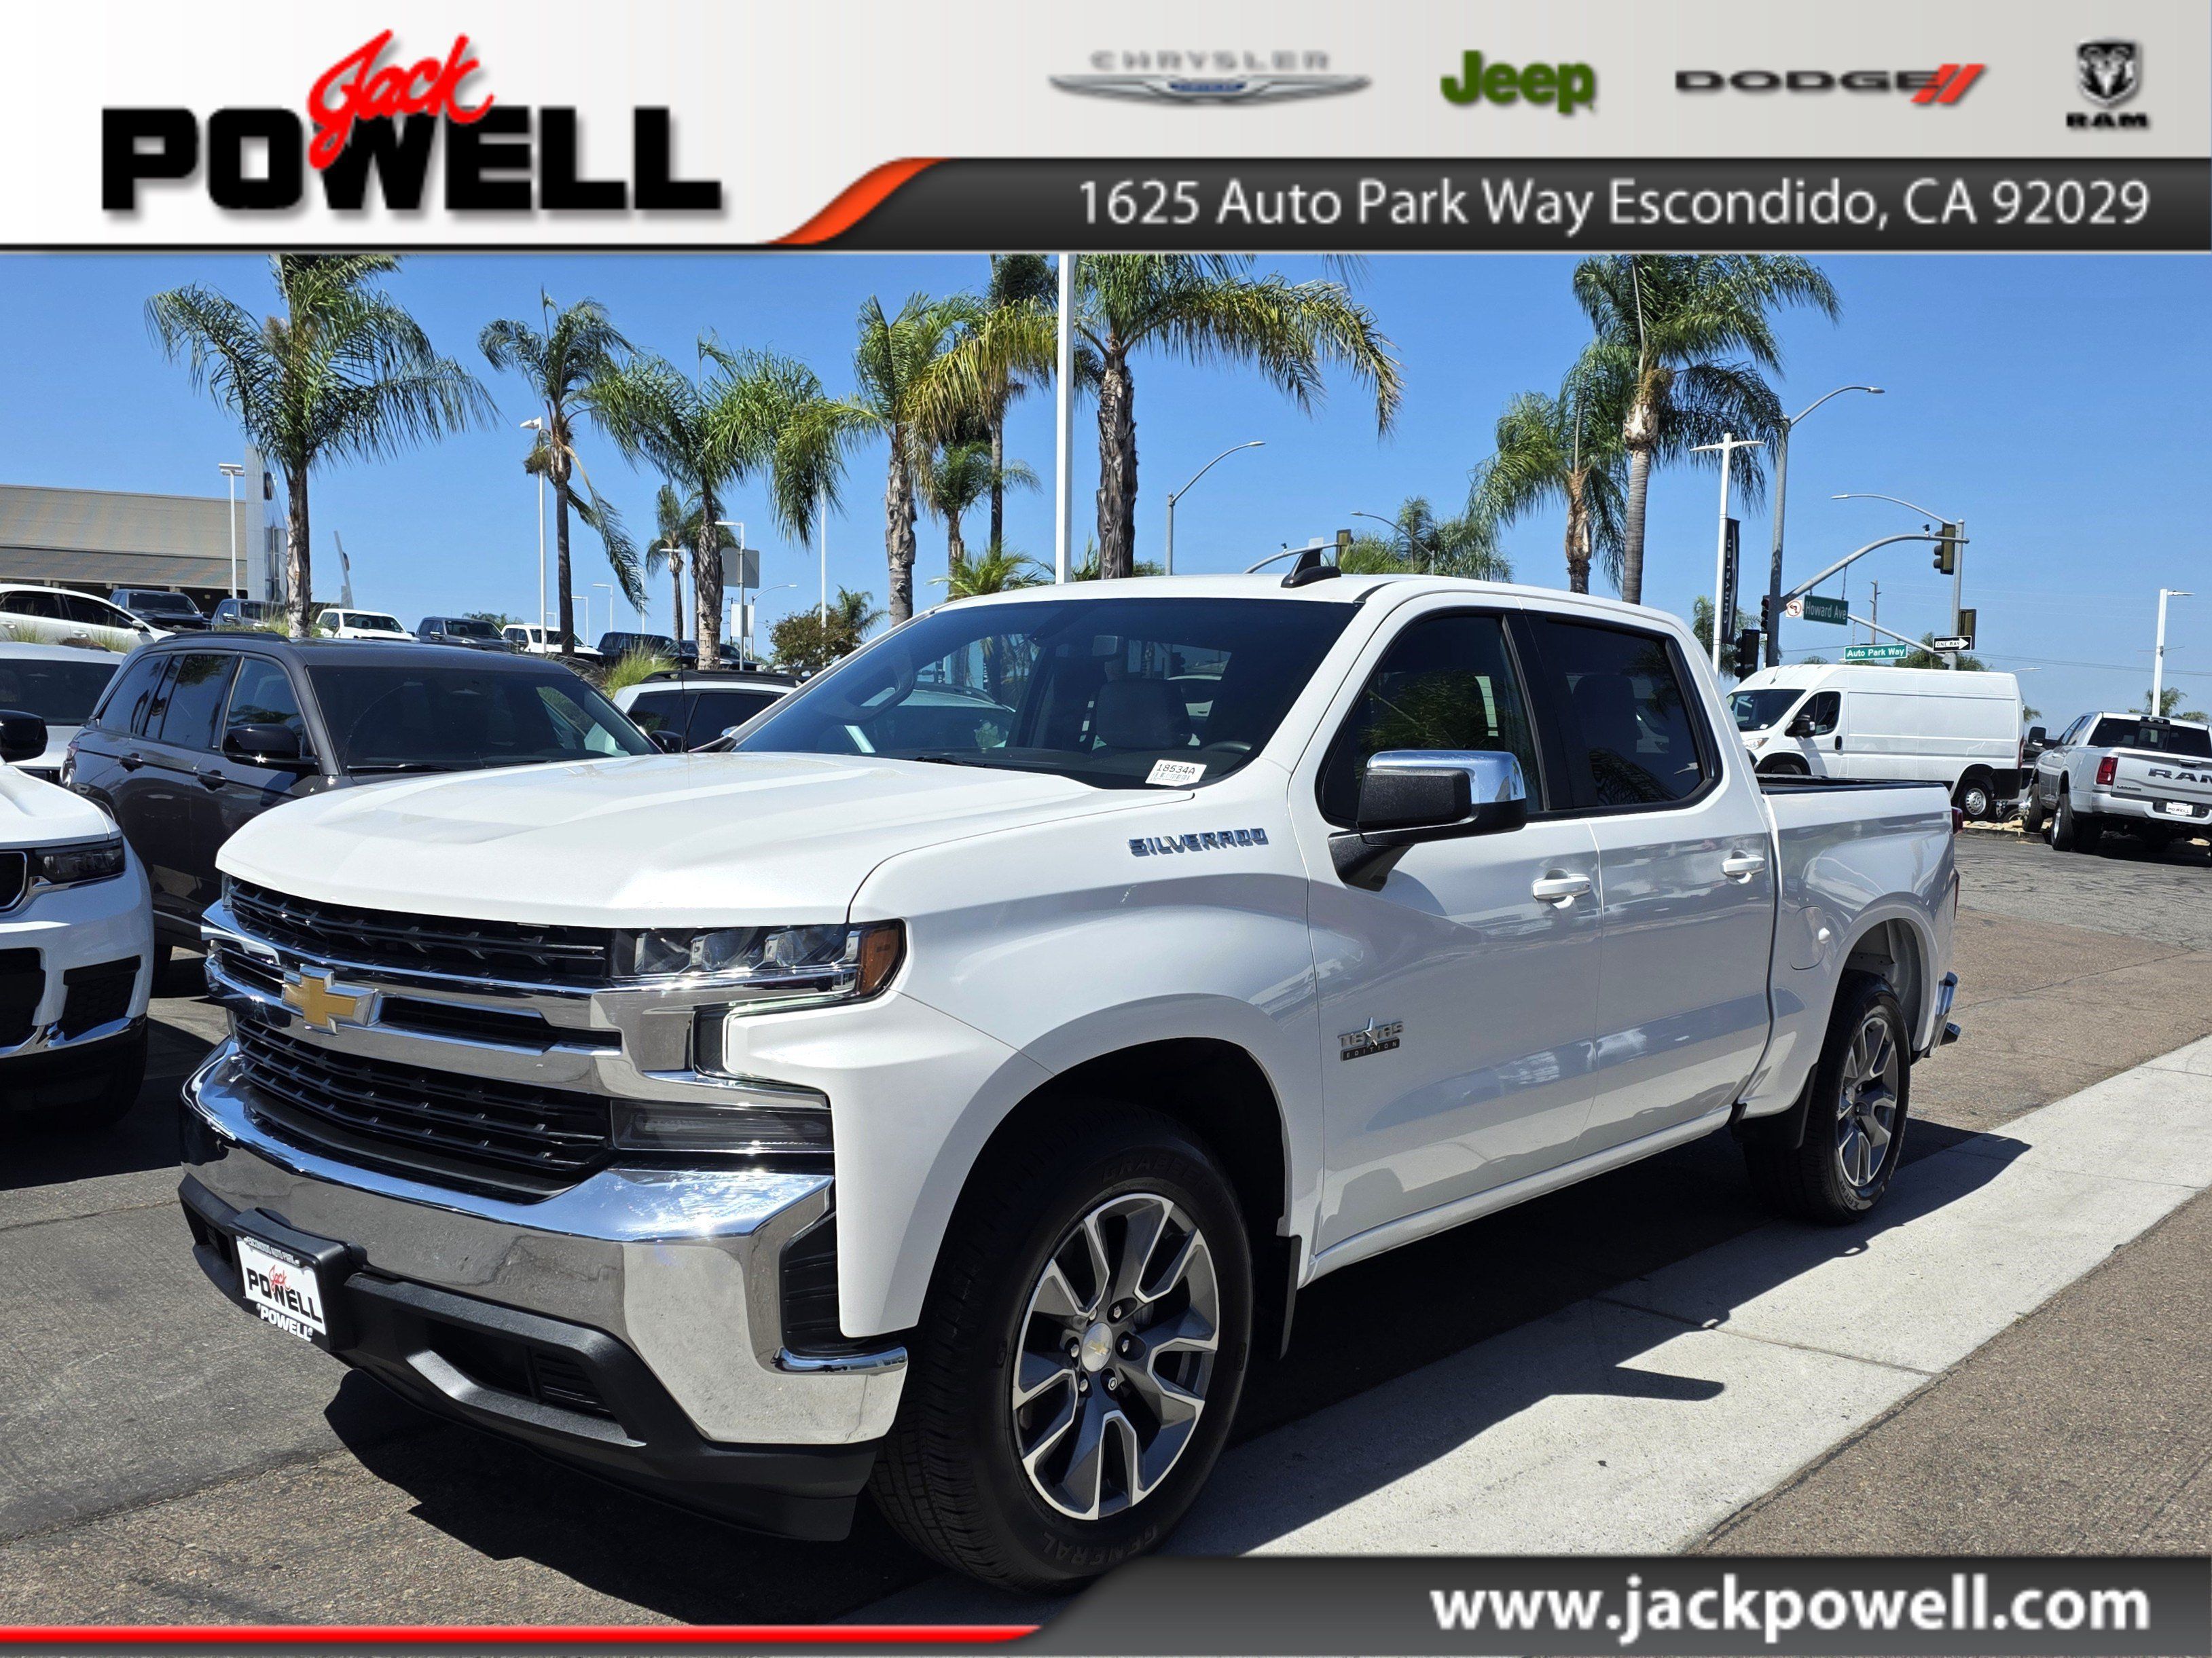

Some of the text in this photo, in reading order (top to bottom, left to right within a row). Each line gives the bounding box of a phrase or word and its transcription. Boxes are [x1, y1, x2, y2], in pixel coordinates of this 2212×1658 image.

[1723, 538, 1733, 624] CHRYSLER
[1805, 600, 1847, 620] Howard Ave
[1847, 646, 1905, 658] Auto Park Way
[1156, 763, 1195, 775] 18534A
[1128, 828, 1269, 856] SILVERADO
[1346, 1041, 1398, 1058] EDITION
[268, 1264, 291, 1293] Jack
[246, 1267, 323, 1324] POWELL
[260, 1306, 312, 1342] POWELL
